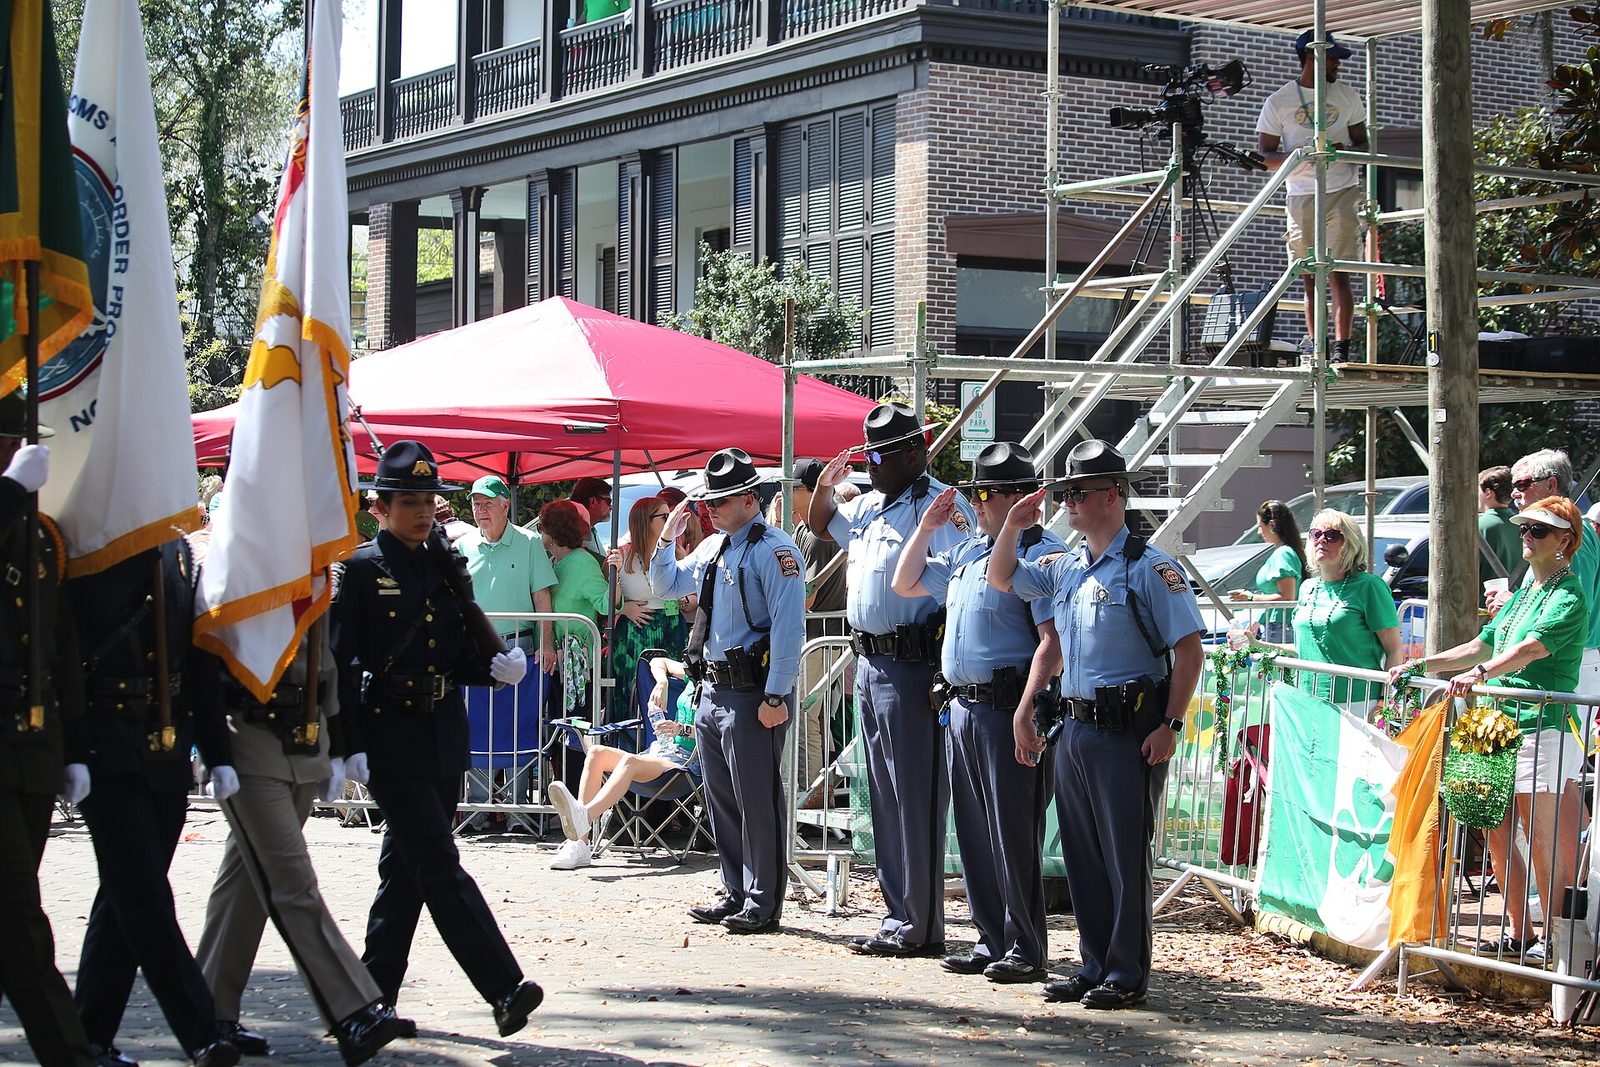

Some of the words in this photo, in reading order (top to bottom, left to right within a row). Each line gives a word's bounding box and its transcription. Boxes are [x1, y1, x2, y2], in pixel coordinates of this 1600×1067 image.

[112, 168, 130, 274] ORDER
[1429, 333, 1435, 352] 1
[1167, 783, 1223, 796] ENTA
